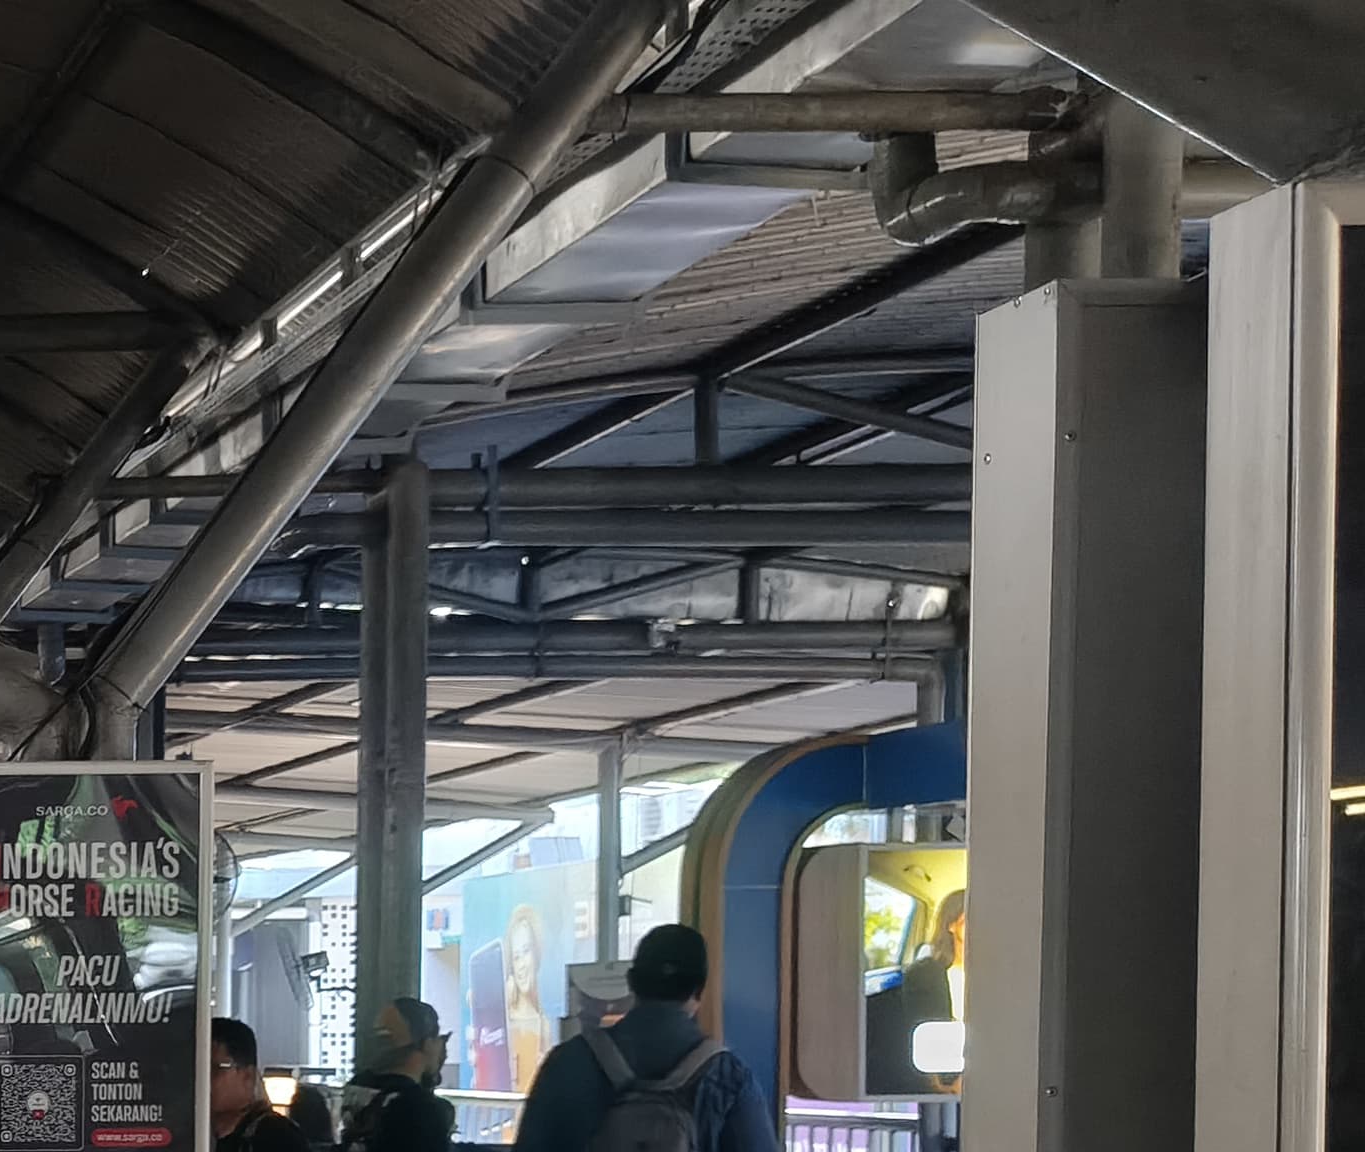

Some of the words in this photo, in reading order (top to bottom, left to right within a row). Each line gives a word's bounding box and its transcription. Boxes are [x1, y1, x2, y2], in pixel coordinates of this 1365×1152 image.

[35, 805, 109, 817] SARGA.CO
[85, 882, 180, 917] RACING
[56, 955, 121, 987] PACU
[91, 1062, 126, 1079] SCAN
[129, 1062, 140, 1079] &
[91, 1083, 143, 1101] TONTON
[91, 1104, 163, 1122] SEKARANG!
